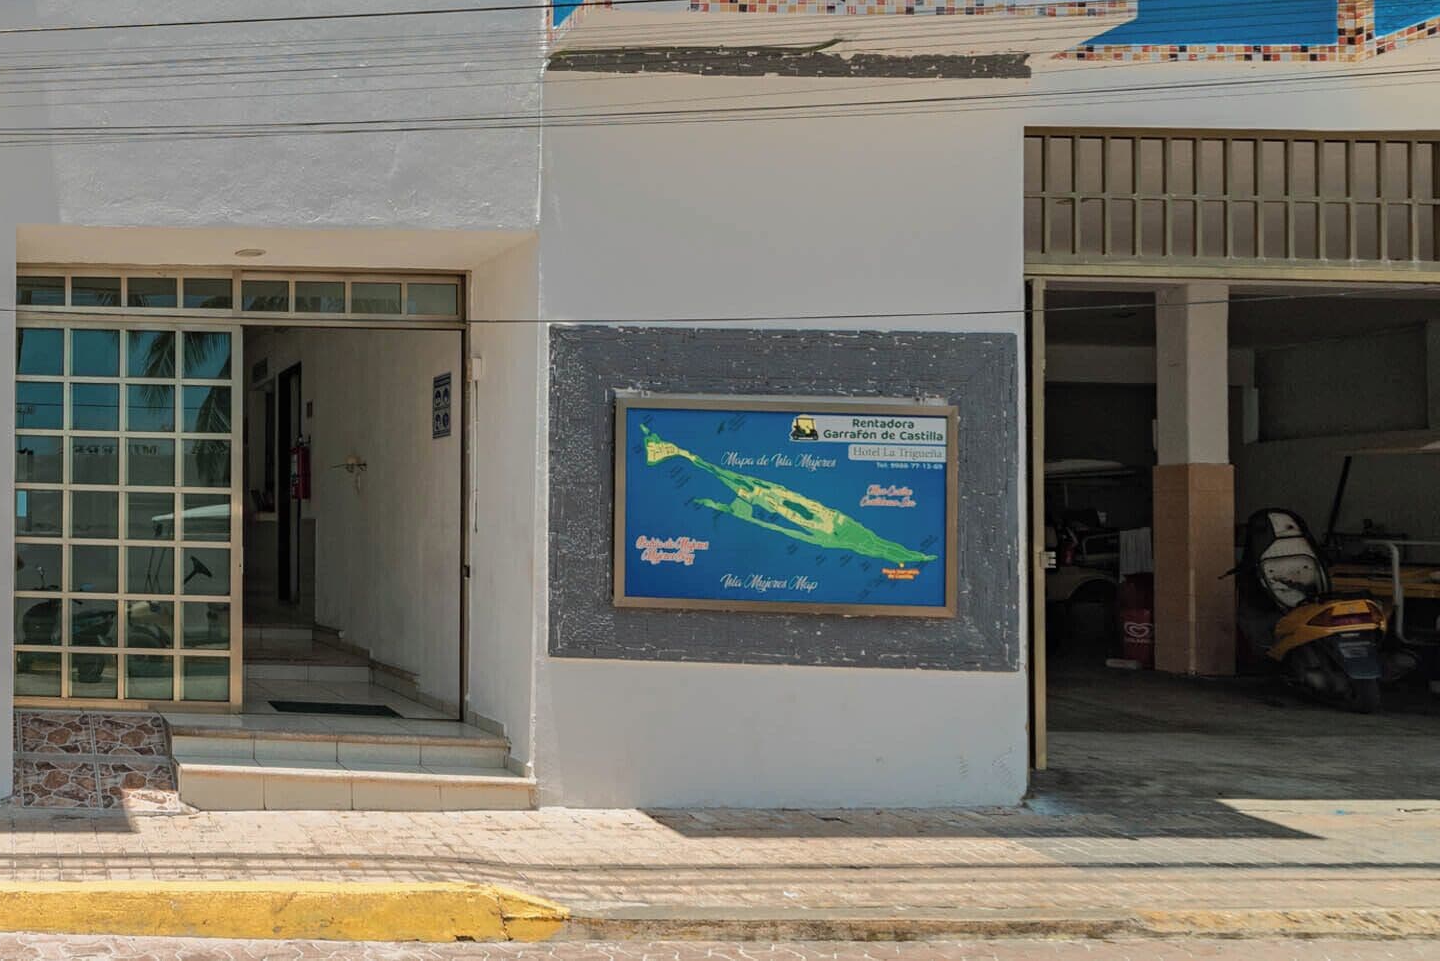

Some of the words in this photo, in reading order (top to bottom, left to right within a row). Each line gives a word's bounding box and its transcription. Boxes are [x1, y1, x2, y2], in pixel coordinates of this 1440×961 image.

[852, 418, 915, 429] Rentadora
[823, 429, 877, 440] Garrafón
[881, 430, 895, 440] de
[899, 430, 943, 441] Castilla
[853, 446, 880, 457] Hotel
[883, 447, 896, 458] La
[899, 447, 943, 460] Trigueña
[720, 451, 754, 468] Mapa
[756, 454, 769, 466] de
[771, 453, 793, 468] Isla
[794, 453, 837, 472] Mujeres
[720, 573, 741, 589] Isla
[743, 574, 787, 592] Mujeres
[788, 575, 818, 593] Map
